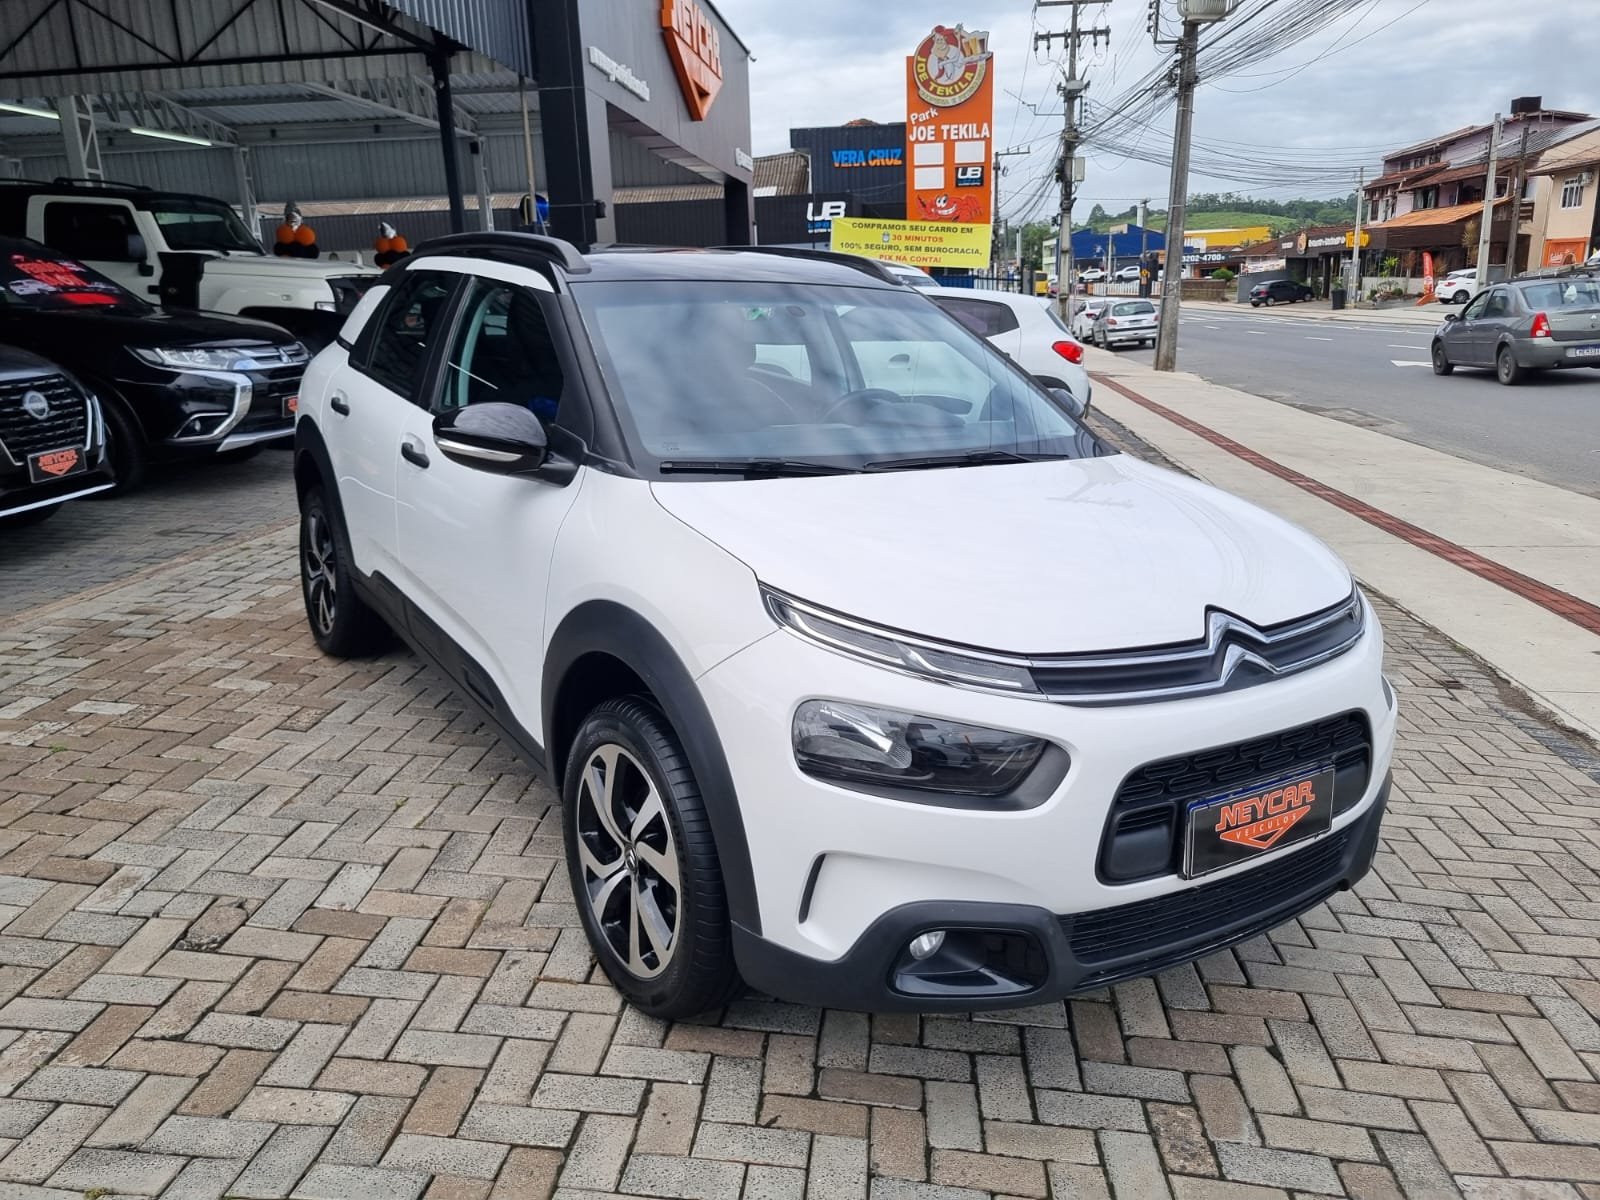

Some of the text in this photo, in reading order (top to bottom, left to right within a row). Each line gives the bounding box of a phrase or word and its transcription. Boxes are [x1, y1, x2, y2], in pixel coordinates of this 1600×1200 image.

[917, 56, 928, 82] JOE
[928, 71, 975, 96] TEKILA
[910, 107, 939, 124] Park
[909, 122, 990, 141] JOE TEKILA
[832, 148, 903, 168] VERA CRUZ
[851, 222, 907, 231] COMPRAMOS
[908, 224, 926, 232] SEU
[904, 234, 944, 243] MINUTOS
[840, 242, 983, 255] 100% SEGURO, SEM BUROCRACIA,
[1215, 781, 1316, 832] NEYCAR
